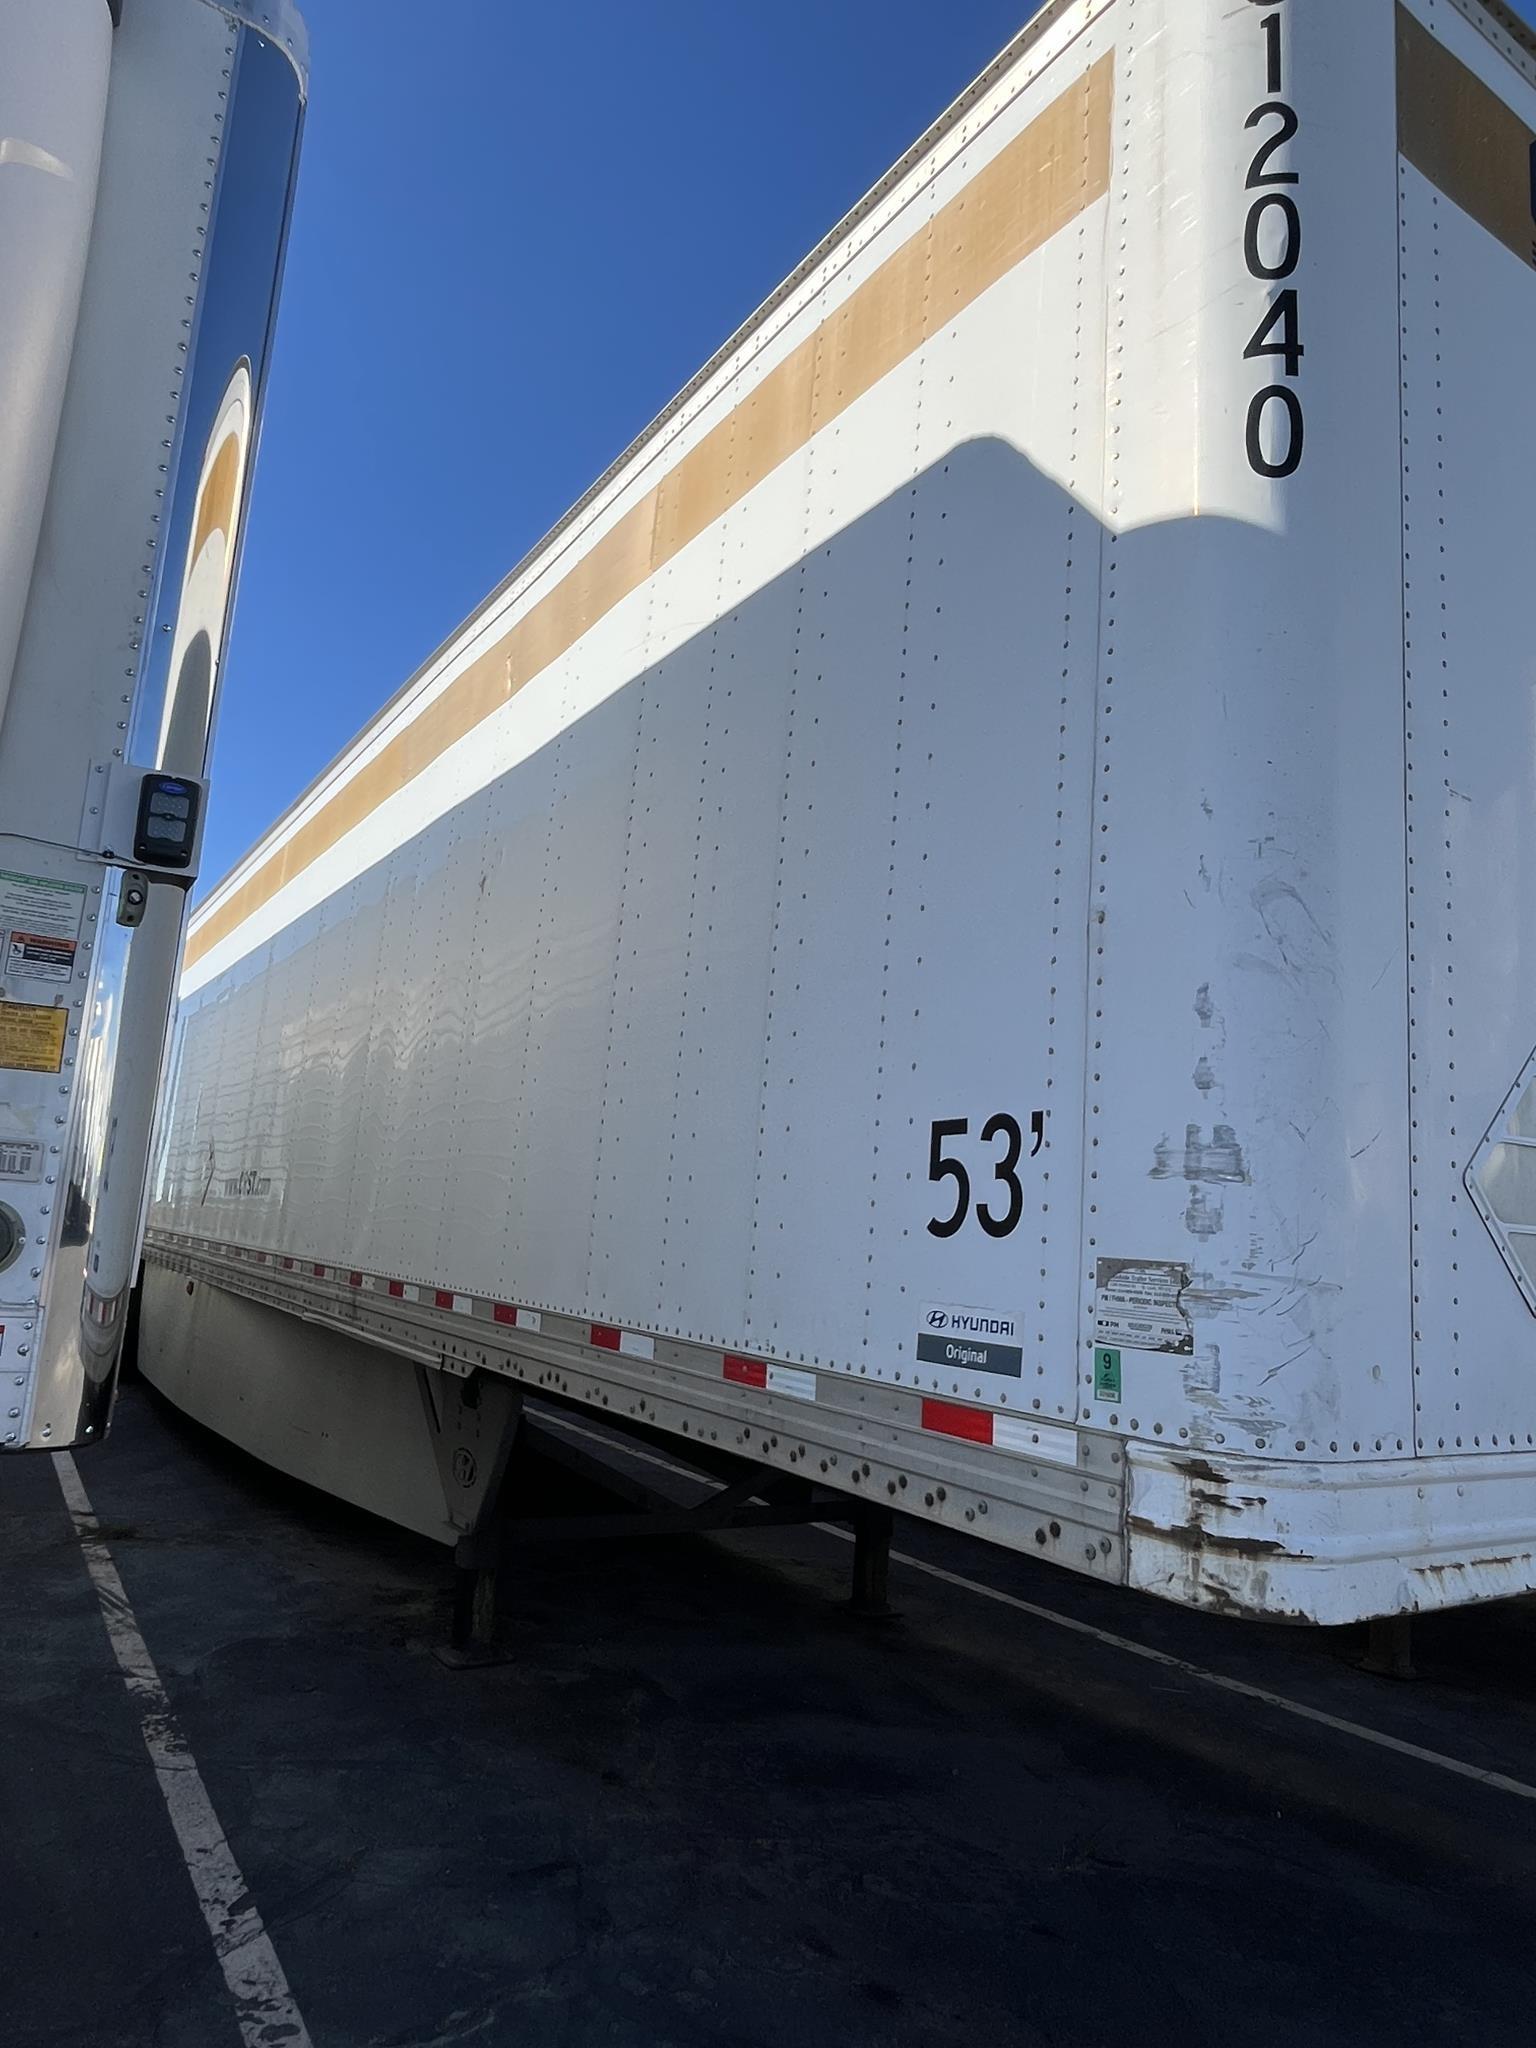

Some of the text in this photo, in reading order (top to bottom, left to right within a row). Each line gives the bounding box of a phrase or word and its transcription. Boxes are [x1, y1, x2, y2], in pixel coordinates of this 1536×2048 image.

[1243, 0, 1304, 478] 12040
[927, 1110, 1043, 1238] 53'
[951, 1314, 1015, 1337] HYUNDAI
[946, 1344, 988, 1364] Original
[1103, 1352, 1112, 1370] 9
